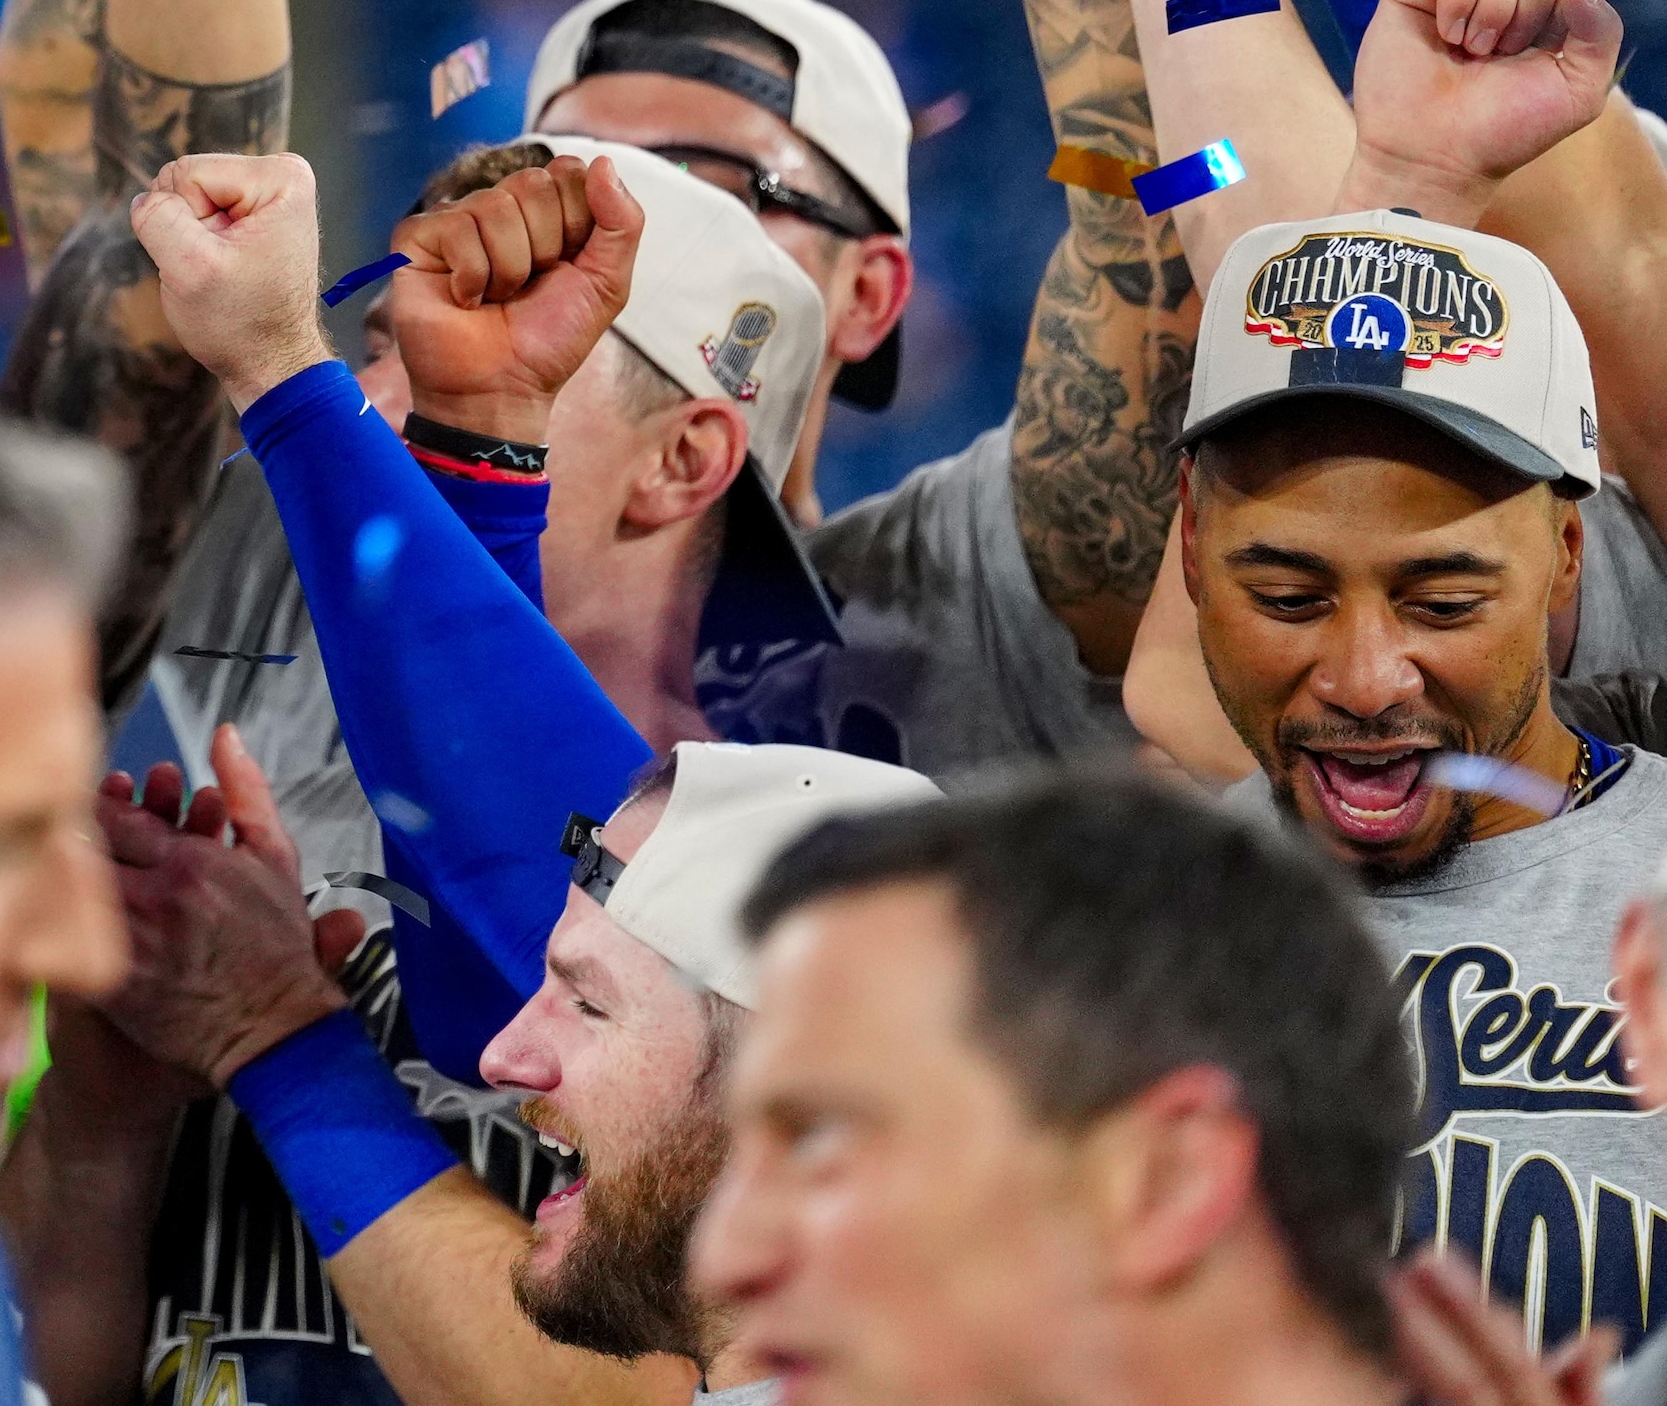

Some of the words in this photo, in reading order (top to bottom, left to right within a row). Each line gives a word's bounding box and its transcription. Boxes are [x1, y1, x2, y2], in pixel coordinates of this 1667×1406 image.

[1325, 236, 1384, 262] World
[1375, 239, 1436, 270] Series
[1258, 254, 1496, 339] CHAMPIONS
[1302, 320, 1323, 340] 20
[1345, 302, 1390, 351] LA
[1416, 334, 1435, 353] 25
